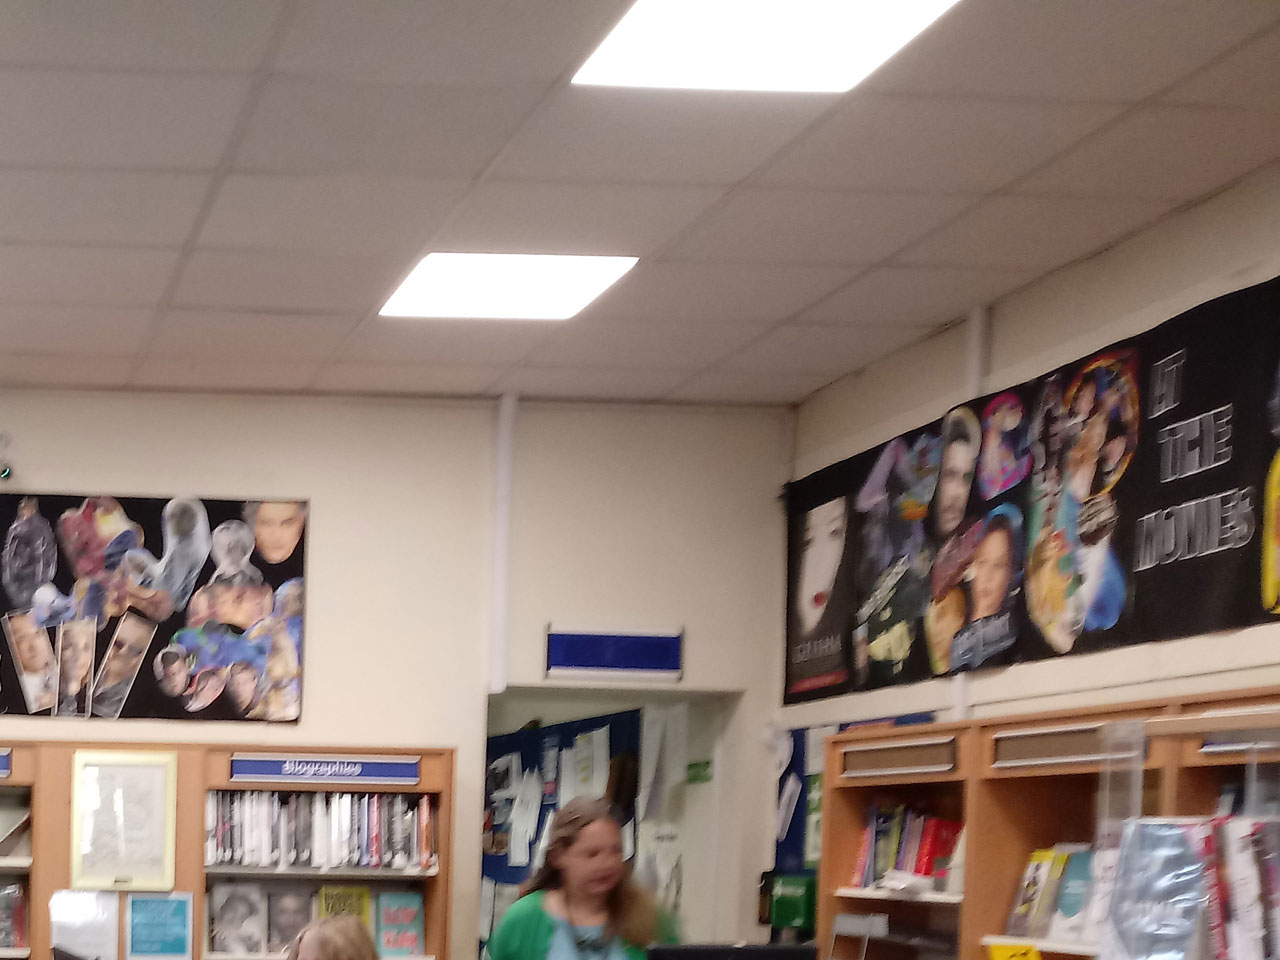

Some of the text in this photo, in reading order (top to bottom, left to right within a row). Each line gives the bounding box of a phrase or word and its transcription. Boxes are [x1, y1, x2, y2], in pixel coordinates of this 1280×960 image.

[1158, 402, 1233, 483] THE
[1133, 486, 1256, 573] MOVIES
[282, 760, 363, 776] Biographies
